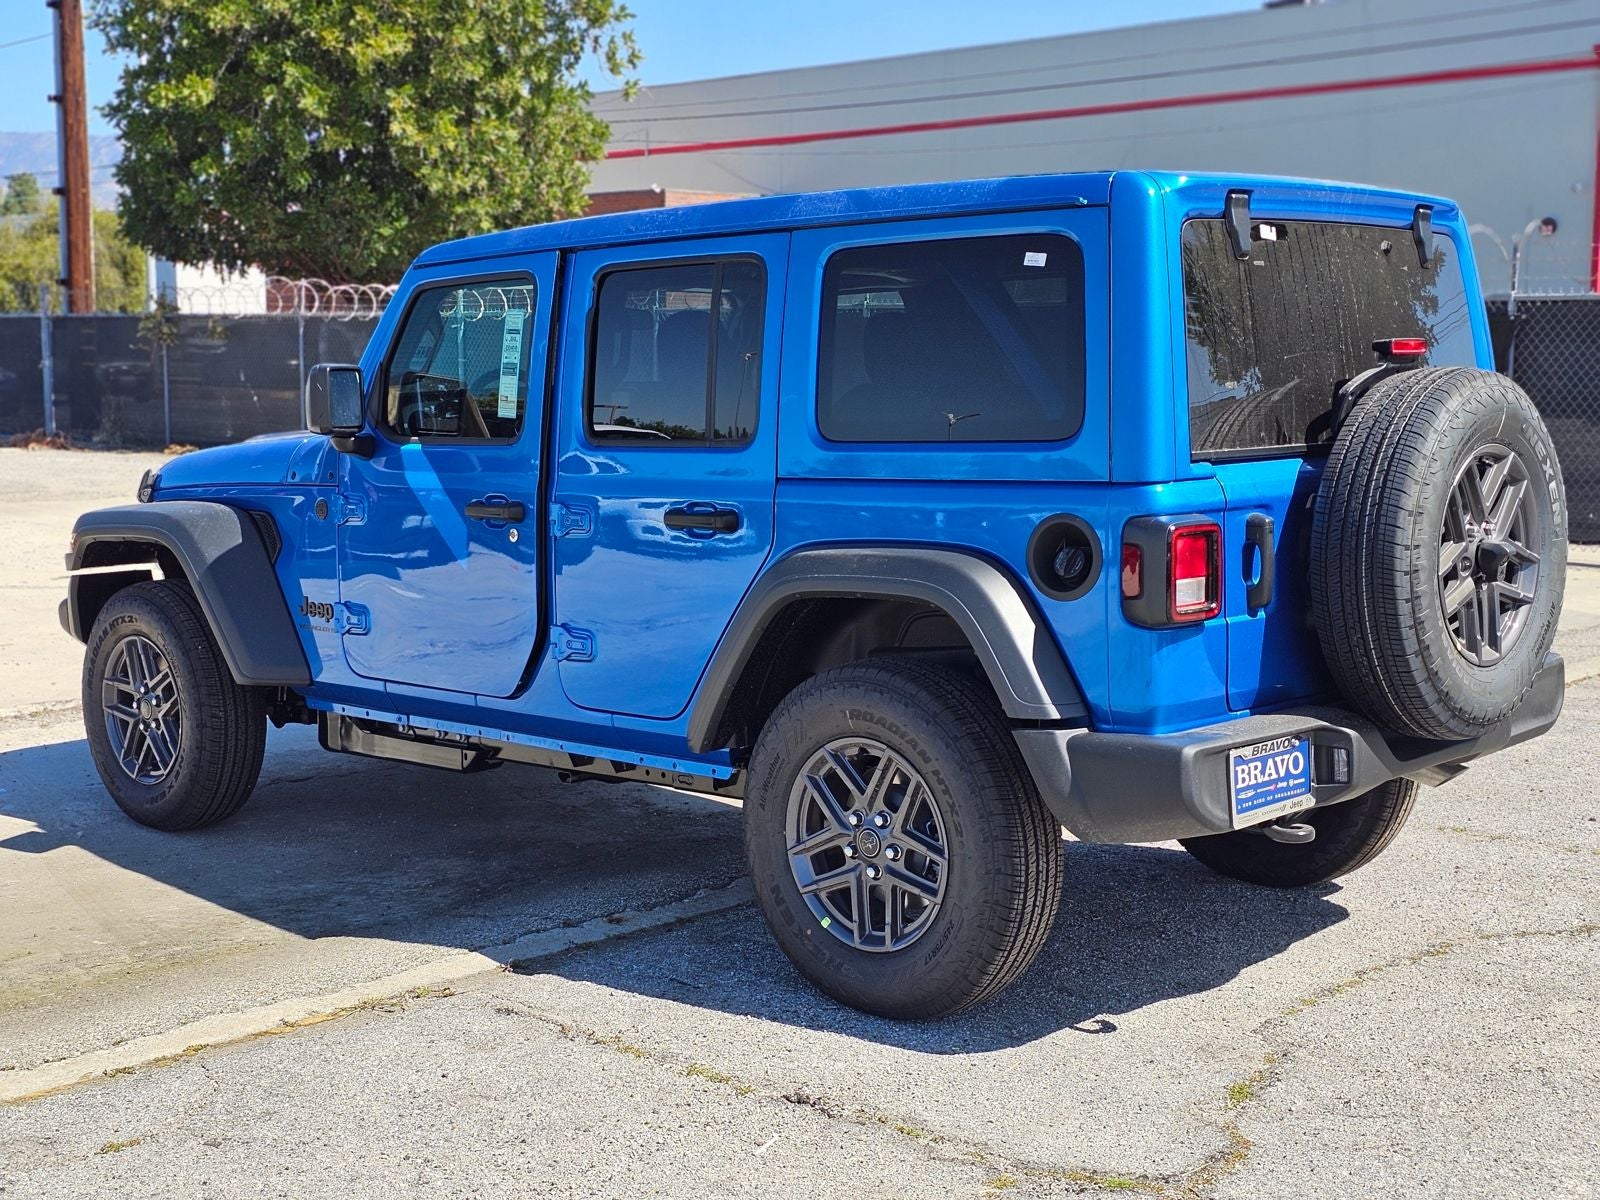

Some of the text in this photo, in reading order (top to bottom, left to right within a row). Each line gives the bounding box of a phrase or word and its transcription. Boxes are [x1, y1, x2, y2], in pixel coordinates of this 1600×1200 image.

[1524, 425, 1563, 526] NEXEN
[109, 615, 135, 631] HTX2
[298, 595, 335, 623] Jeep
[849, 708, 933, 765] ROADIAN
[1251, 738, 1291, 757] BRAVO
[1235, 752, 1304, 789] BRAVO
[1290, 799, 1303, 810] Jeep
